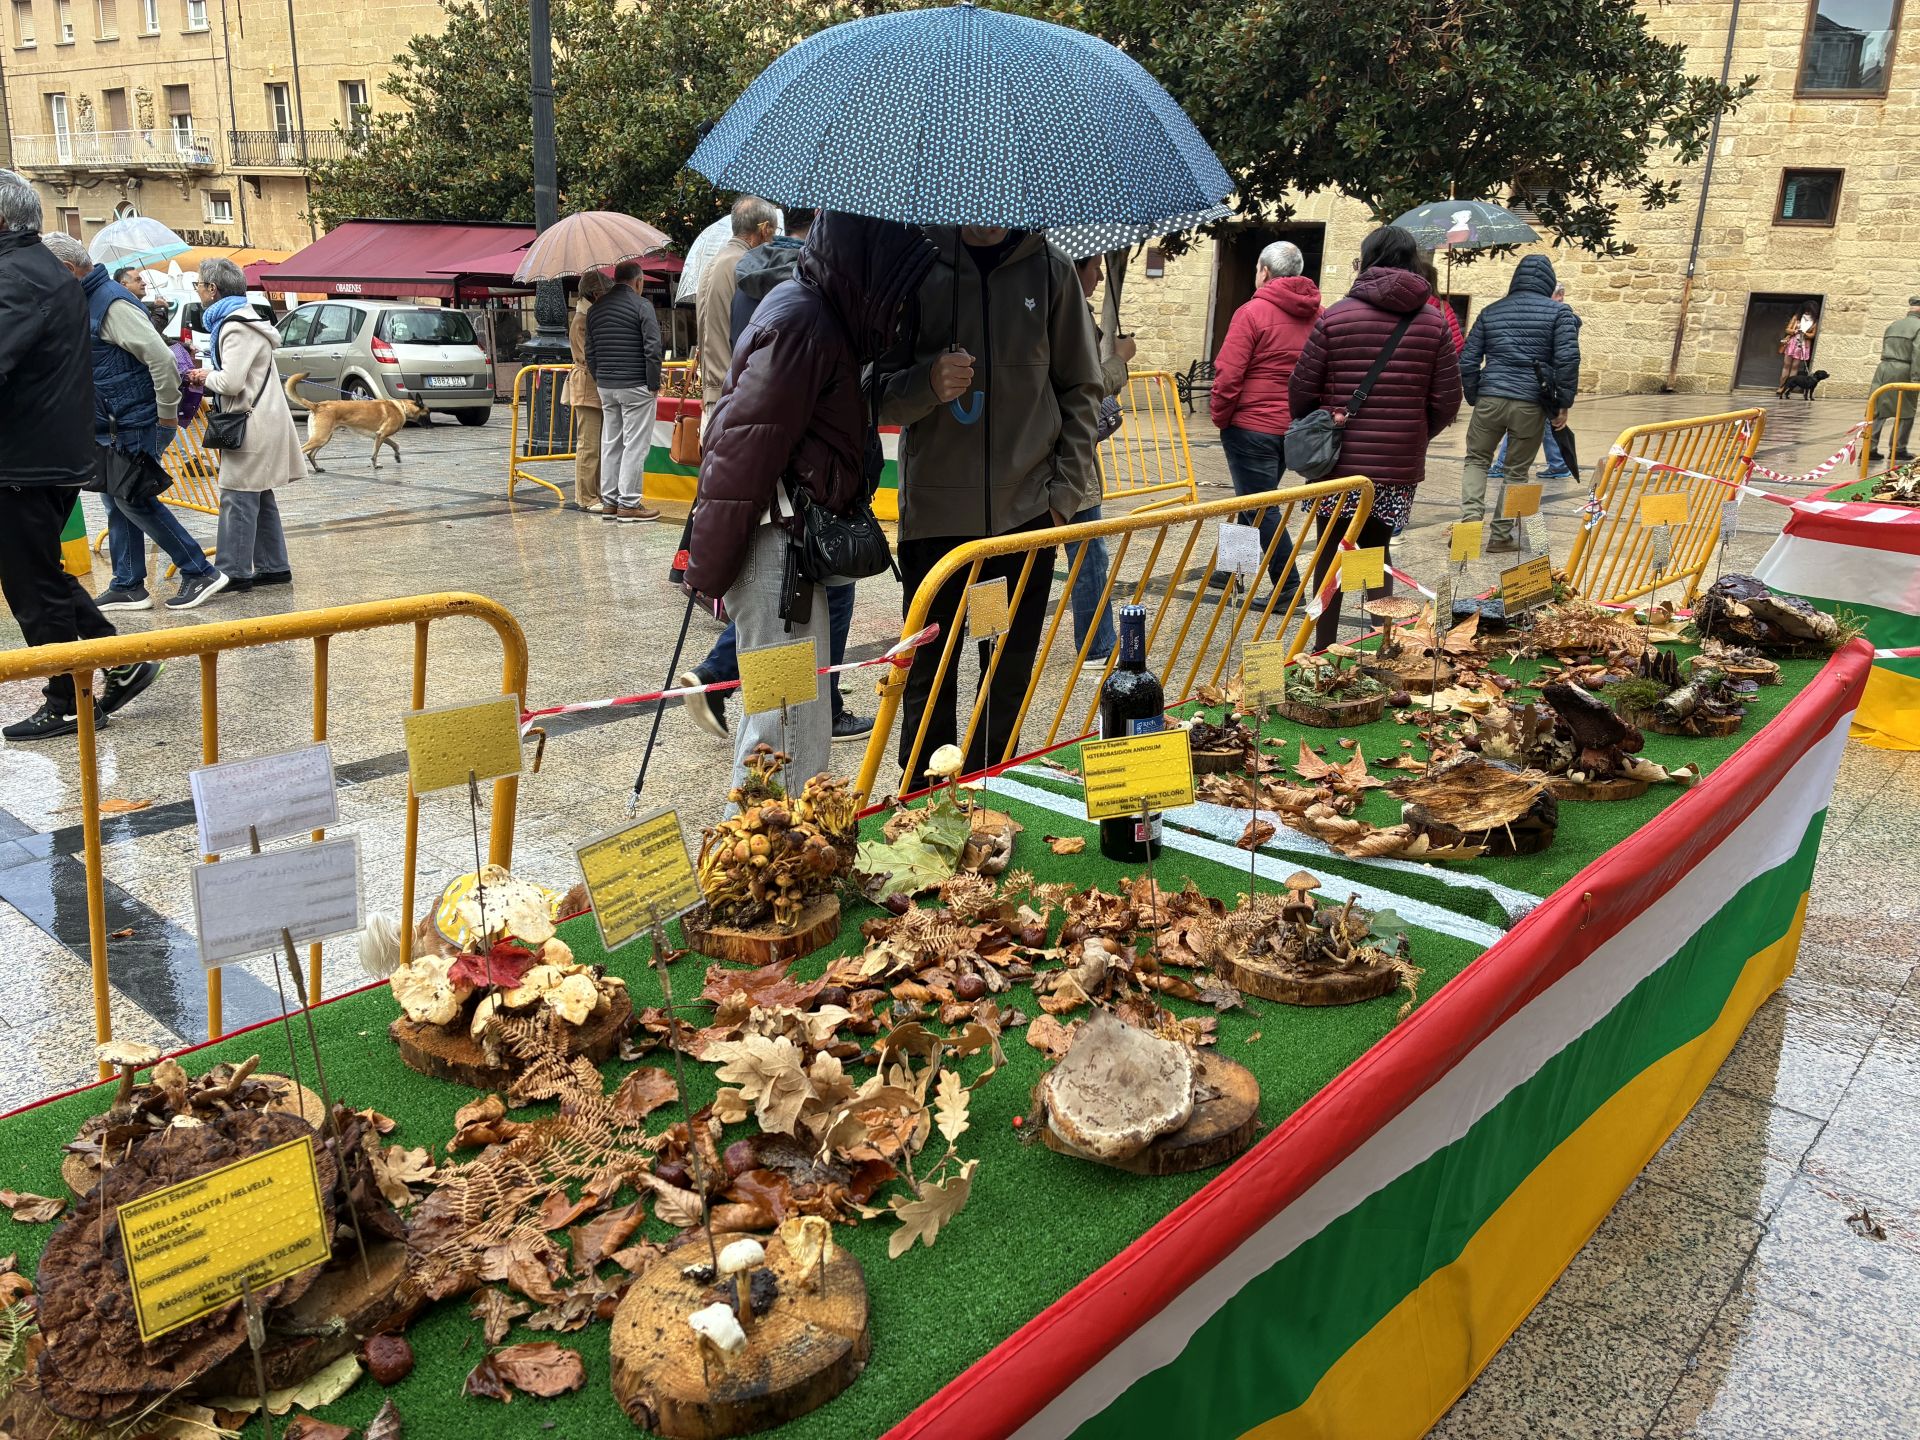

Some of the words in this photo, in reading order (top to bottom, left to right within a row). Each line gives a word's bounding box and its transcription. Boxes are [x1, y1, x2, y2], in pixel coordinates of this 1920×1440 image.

[202, 229, 229, 246] SOL
[335, 283, 362, 293] OBARENES
[1133, 744, 1161, 753] ANNOSUM
[1129, 794, 1157, 802] Deprtiva
[1159, 788, 1184, 798] TOLOÑO
[132, 1215, 178, 1239] HELVELLA
[180, 1197, 222, 1220] SULCATA
[230, 1176, 274, 1199] HELVELLA
[157, 1282, 215, 1312] Asociación
[217, 1259, 266, 1286] Deportiva
[268, 1237, 312, 1261] TOLOÑO
